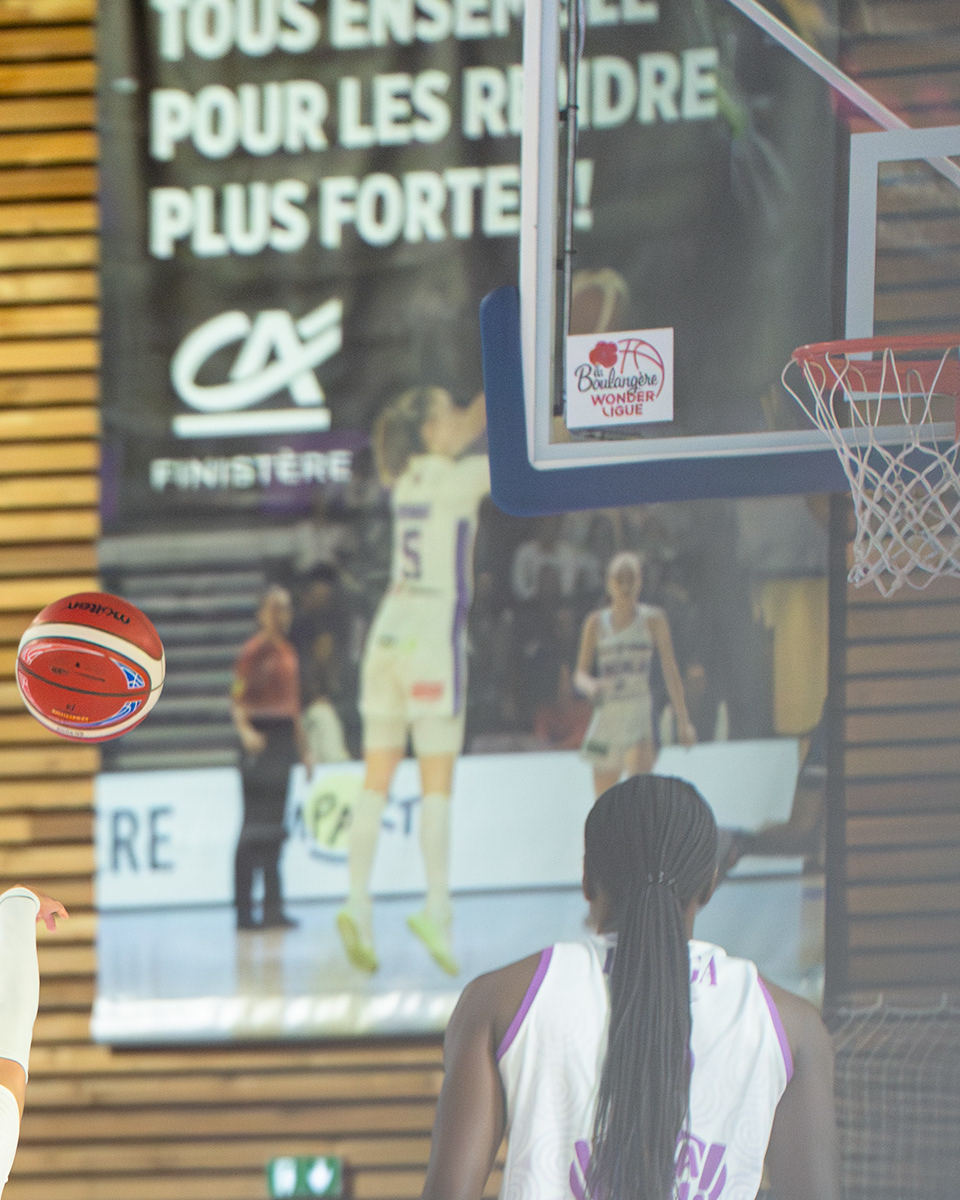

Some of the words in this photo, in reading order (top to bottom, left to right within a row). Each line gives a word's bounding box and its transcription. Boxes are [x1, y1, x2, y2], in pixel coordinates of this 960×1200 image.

[157, 0, 322, 61] TOUS
[149, 80, 329, 161] POUR
[339, 71, 451, 149] LES
[149, 179, 311, 260] PLUS
[319, 164, 522, 250] FORTE
[574, 363, 658, 393] Boulangère
[591, 390, 655, 406] WONDER
[602, 403, 644, 417] LIGUE
[149, 447, 353, 492] FINISTÈRE
